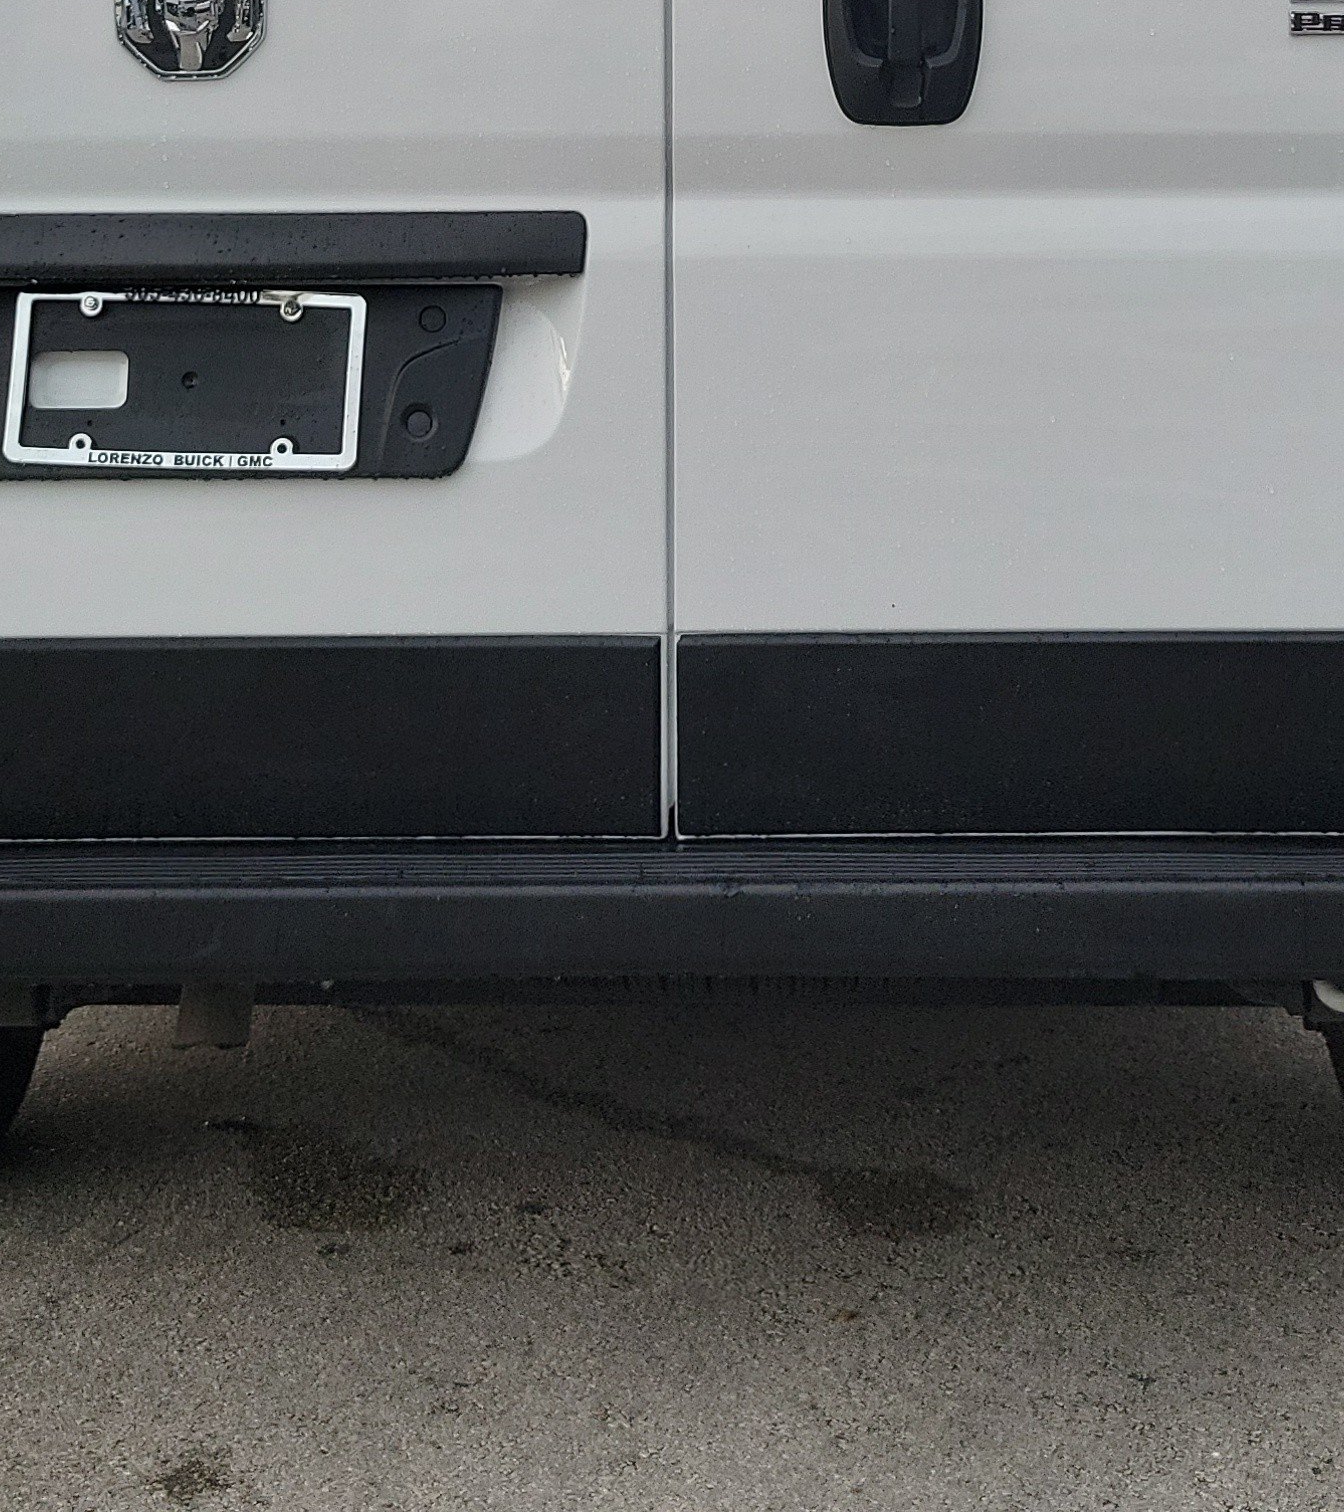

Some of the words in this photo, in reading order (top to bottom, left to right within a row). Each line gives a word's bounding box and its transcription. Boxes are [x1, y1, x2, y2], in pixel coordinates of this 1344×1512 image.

[88, 452, 164, 466] LORENZO
[174, 454, 225, 467] BUICK
[237, 455, 274, 467] GMC
